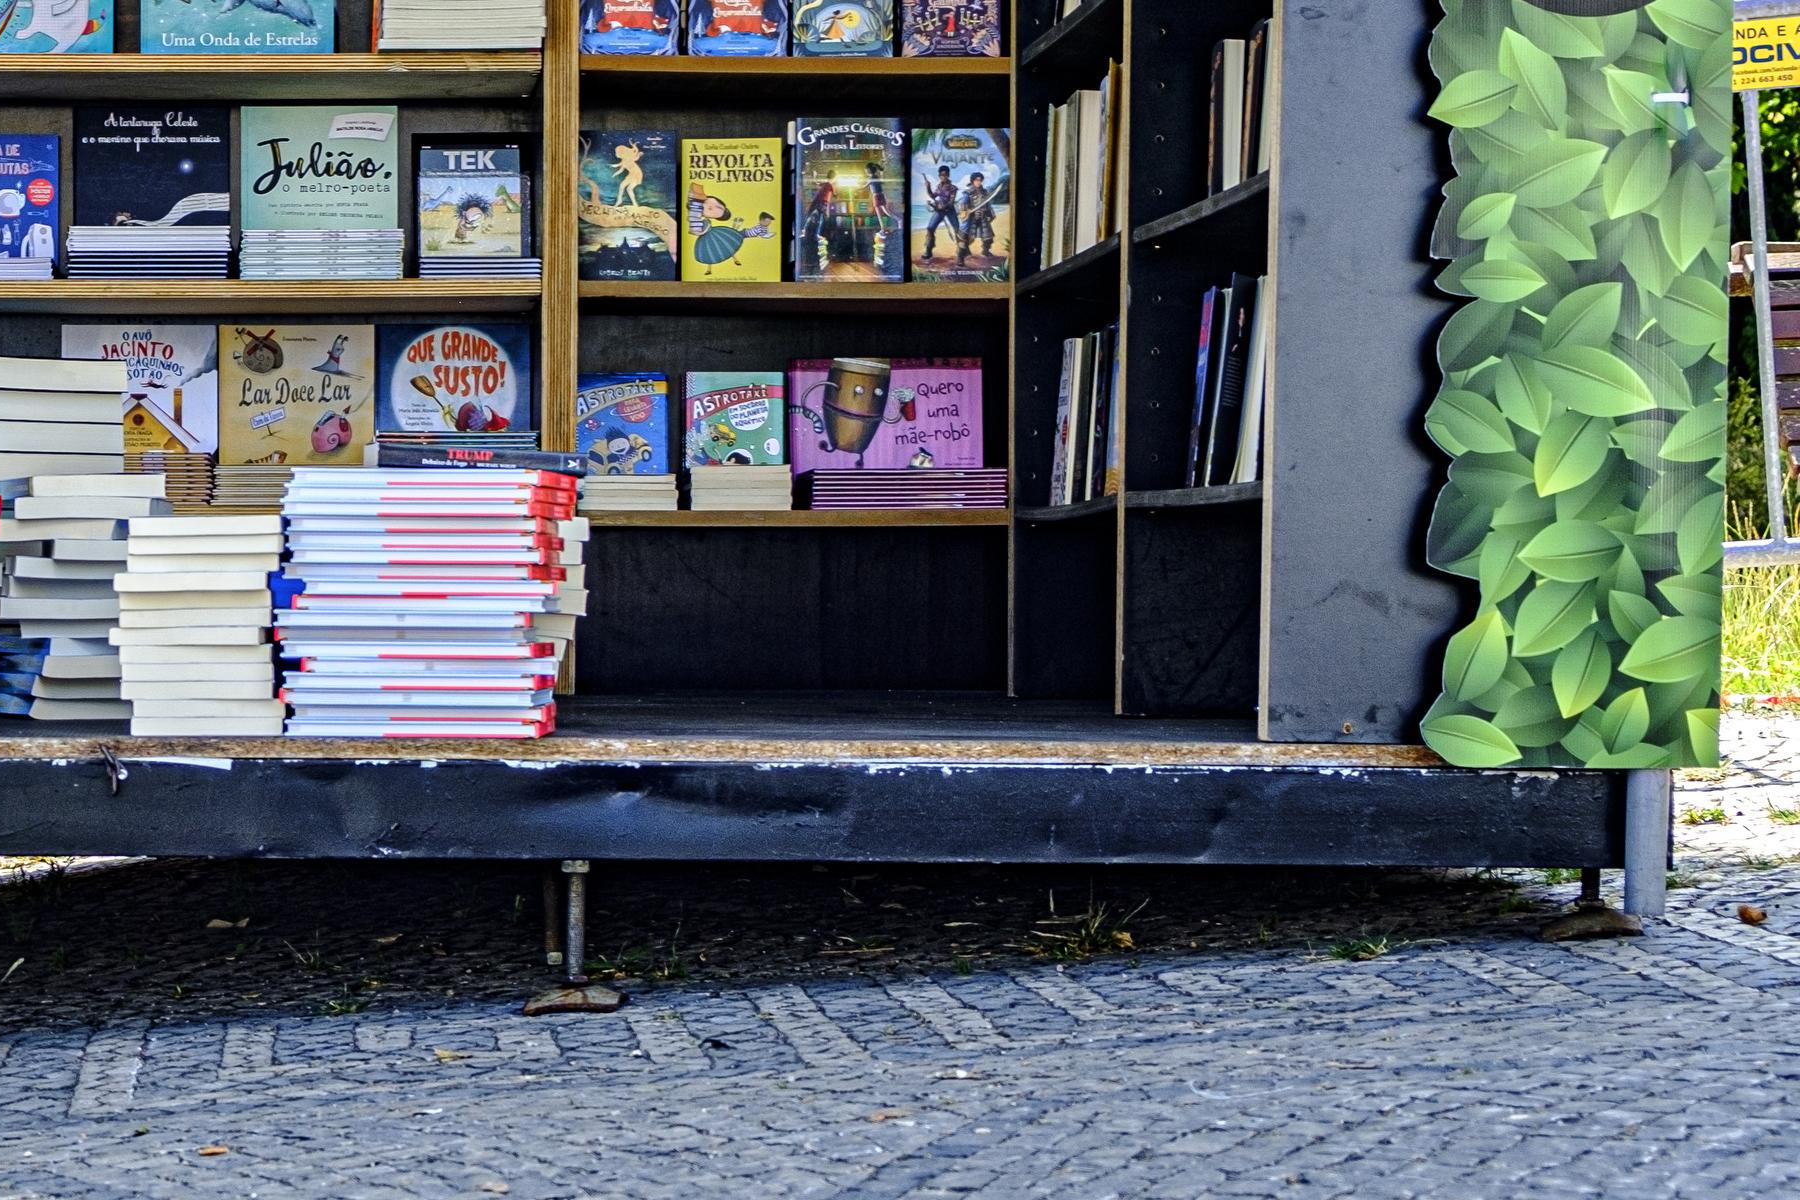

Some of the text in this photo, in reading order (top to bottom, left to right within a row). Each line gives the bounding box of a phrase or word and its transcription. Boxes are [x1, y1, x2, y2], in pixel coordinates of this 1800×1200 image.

[161, 31, 319, 47] Uma Onda de Estrelas
[1777, 25, 1787, 37] E
[797, 122, 906, 146] GRANDES CLÁSSICOS
[6, 144, 20, 156] DE
[690, 144, 699, 153] A
[443, 150, 495, 170] TEK
[689, 153, 774, 169] REVOLTA
[932, 151, 995, 168] VIAJANTE
[689, 169, 775, 183] DOS LIVROS
[300, 182, 391, 196] melro-poeta
[132, 329, 152, 341] AVÔ
[102, 340, 174, 360] JACINTO
[407, 331, 499, 363] QUE GRANDE
[433, 360, 507, 397] SUSTO!
[238, 374, 352, 407] Lar Doce Lar
[917, 381, 964, 397] Quero
[927, 403, 959, 419] uma
[895, 422, 970, 446] mãe-robô
[447, 448, 494, 460] TRUMP
